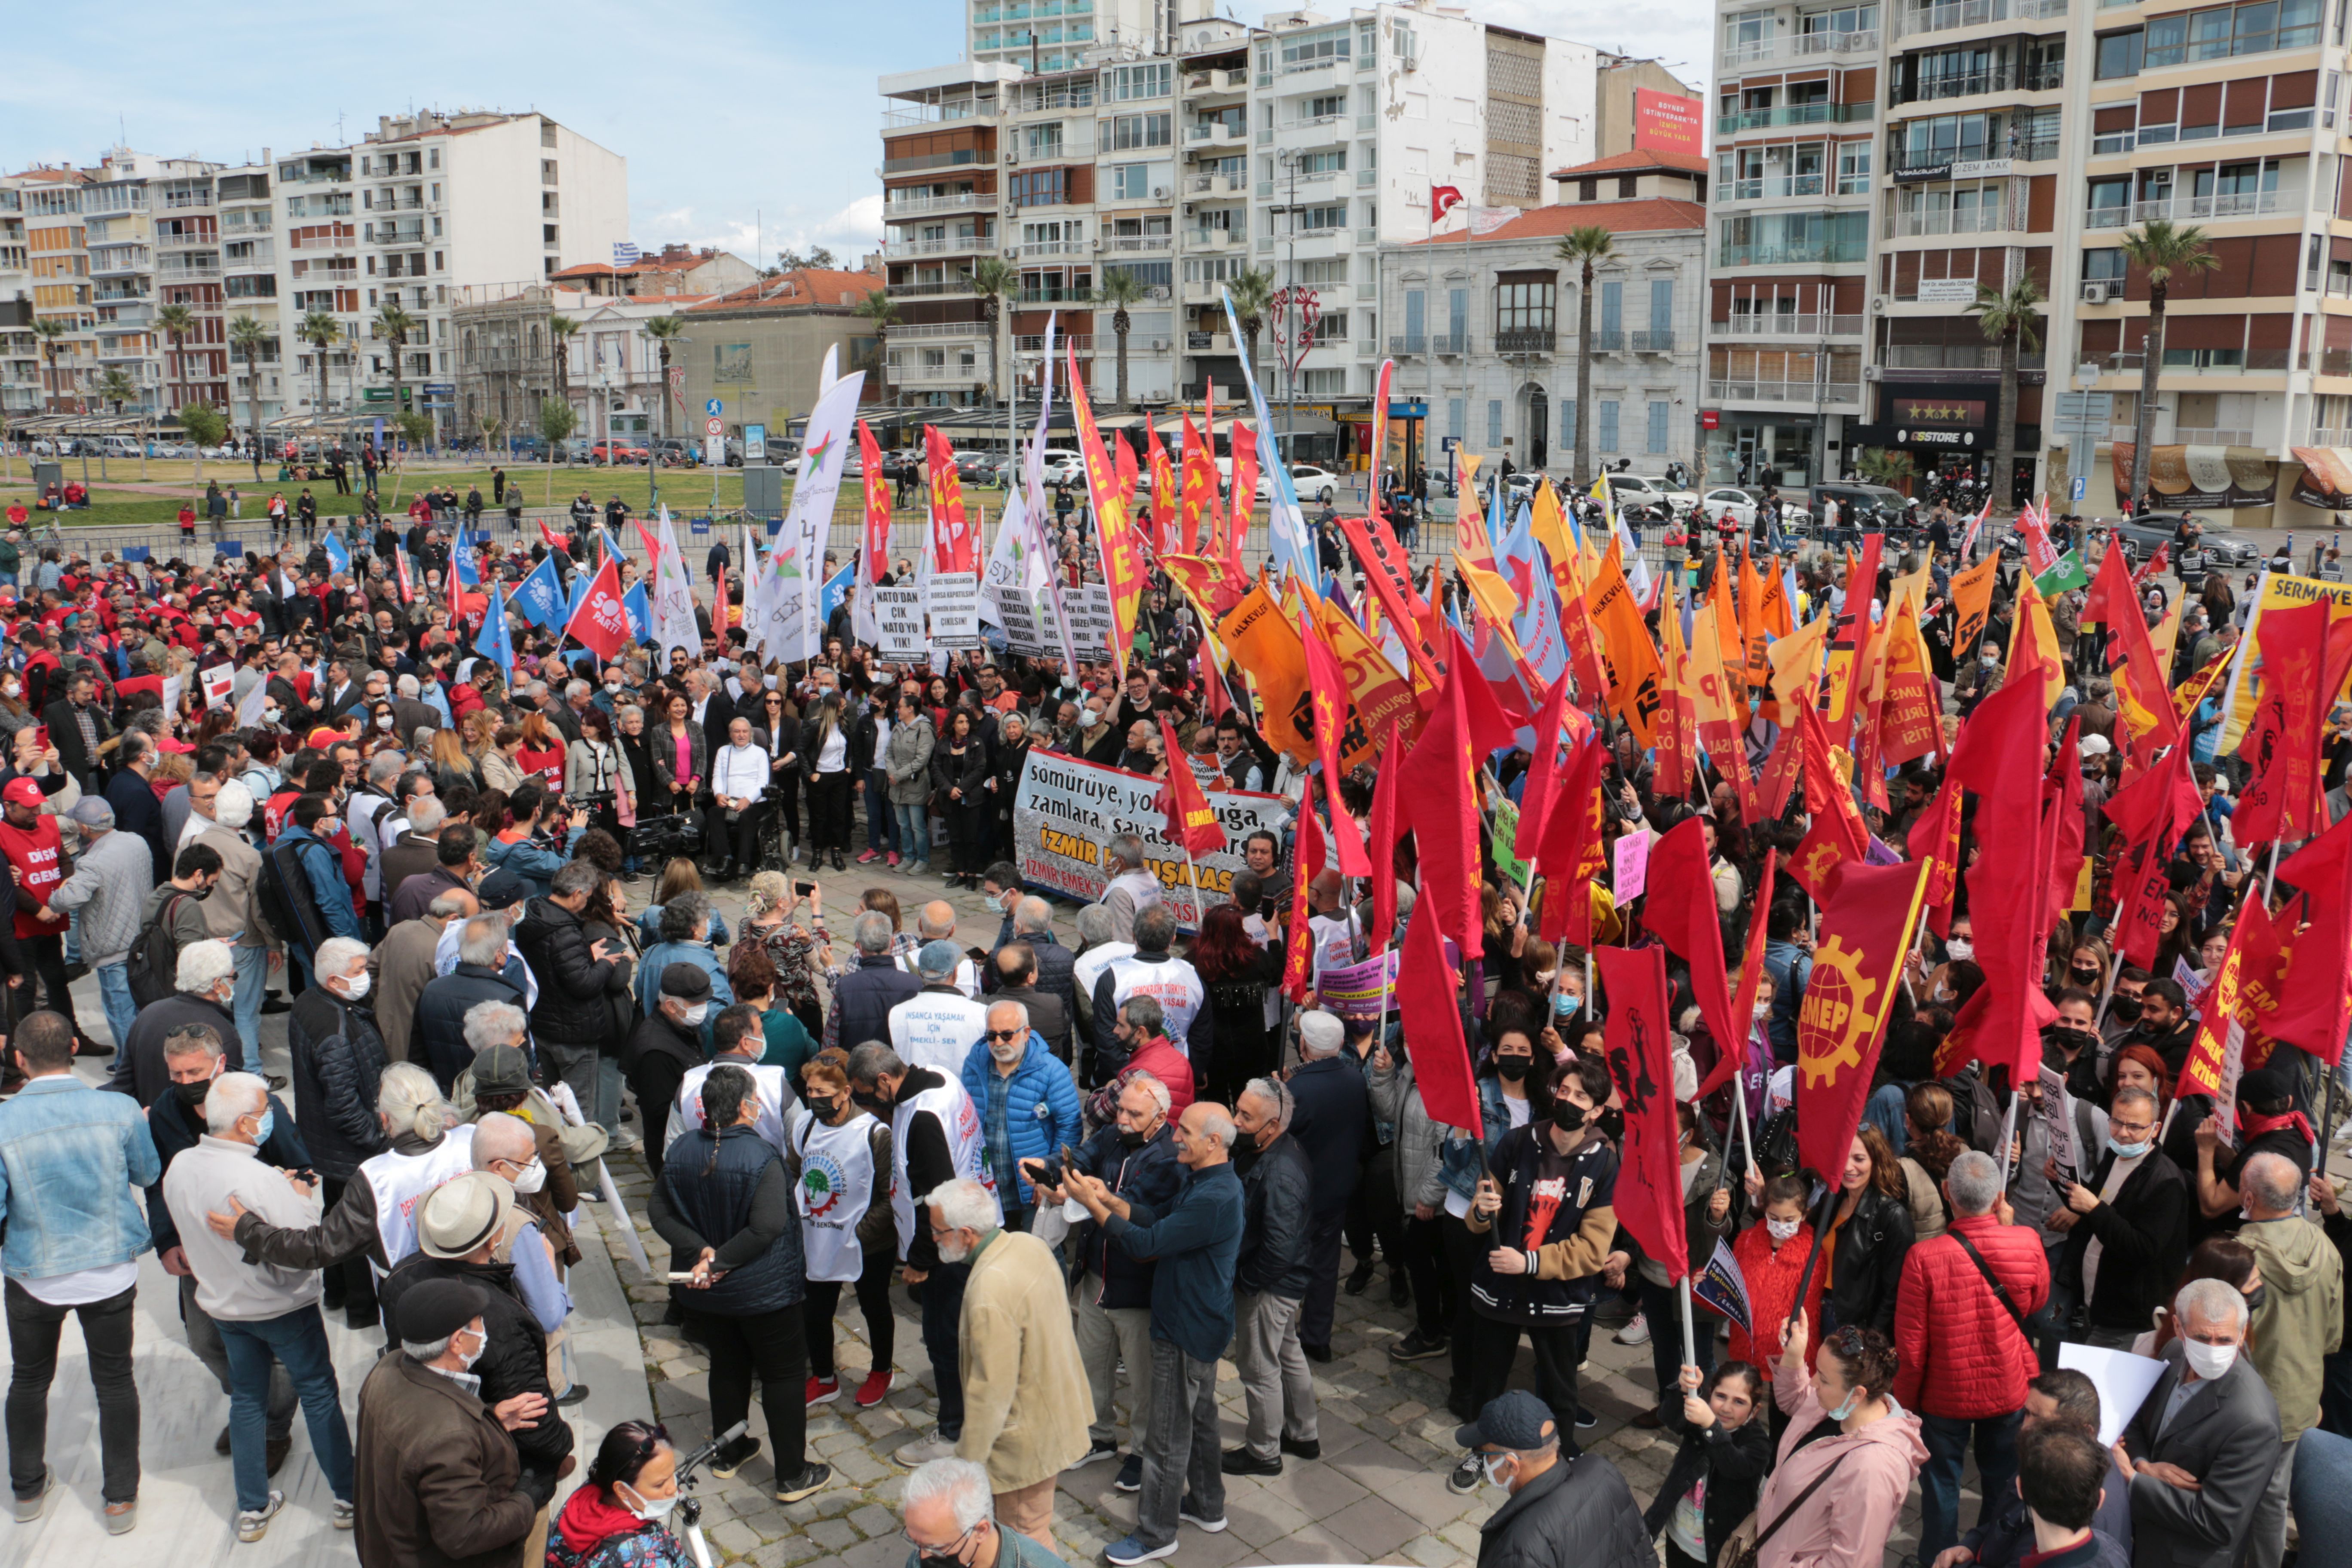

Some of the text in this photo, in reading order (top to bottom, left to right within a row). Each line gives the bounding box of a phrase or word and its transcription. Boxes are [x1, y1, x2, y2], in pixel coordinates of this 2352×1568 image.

[1658, 102, 1685, 113] BOYNER
[1985, 160, 2008, 170] ATAK
[877, 591, 918, 603] NATO'DAN
[1001, 589, 1021, 601] KRİZİ
[591, 591, 622, 627] SOL
[891, 606, 907, 620] ÇIK
[999, 602, 1031, 616] YARATAN
[592, 610, 620, 634] PARTİ
[882, 622, 918, 633] NATO'YU
[941, 617, 967, 628] ÇIKILSIN!
[1002, 616, 1034, 630] BEDELİNİ
[893, 637, 911, 648] YIK!
[1008, 628, 1037, 643] ÖDESİN!
[1196, 764, 1218, 775] işçiler
[1031, 761, 1122, 808] sömürüye,
[1028, 794, 1106, 834] zamlara,
[1040, 821, 1098, 866] İZMİR
[28, 846, 58, 864] DİSK
[28, 867, 61, 885] GENE
[1025, 854, 1060, 884] İZMİR
[1061, 870, 1093, 896] EMEK
[1132, 982, 1187, 997] DEMOKRATİK TÜRKİYE
[1164, 998, 1186, 1009] YAŞAM
[906, 1010, 965, 1023] İNSANCA YAŞAMAK
[927, 1022, 940, 1034] İÇİN
[1721, 1298, 1743, 1319] EKMEK
